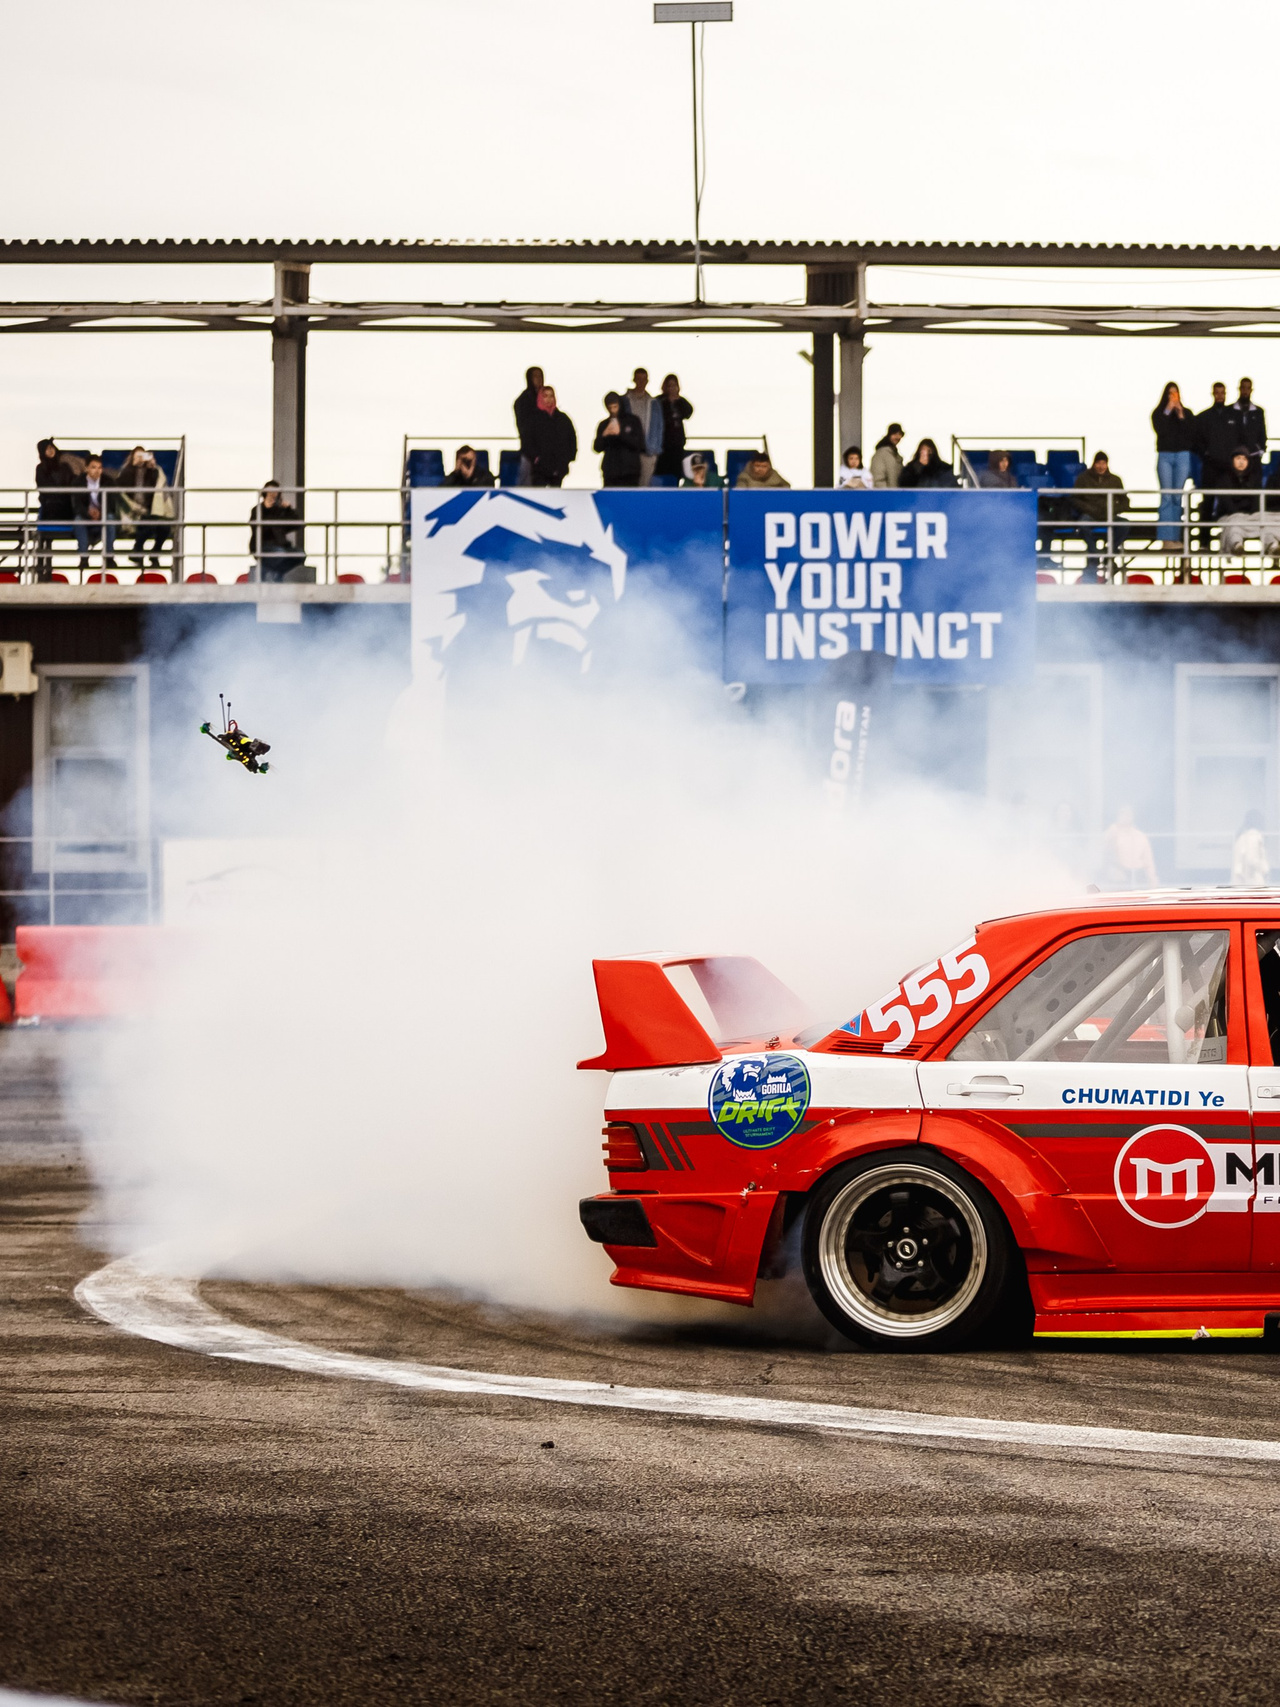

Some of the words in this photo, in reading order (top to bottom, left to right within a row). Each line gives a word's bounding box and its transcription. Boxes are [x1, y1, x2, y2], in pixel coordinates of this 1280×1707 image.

[764, 512, 948, 559] POWER
[764, 562, 902, 609] YOUR
[765, 612, 1002, 659] INSTINCT
[866, 935, 990, 1053] 555
[717, 1096, 801, 1124] DRIFT
[761, 1082, 792, 1095] GORILLA
[1062, 1088, 1190, 1106] CHUMATIDI
[1198, 1091, 1225, 1107] Ye
